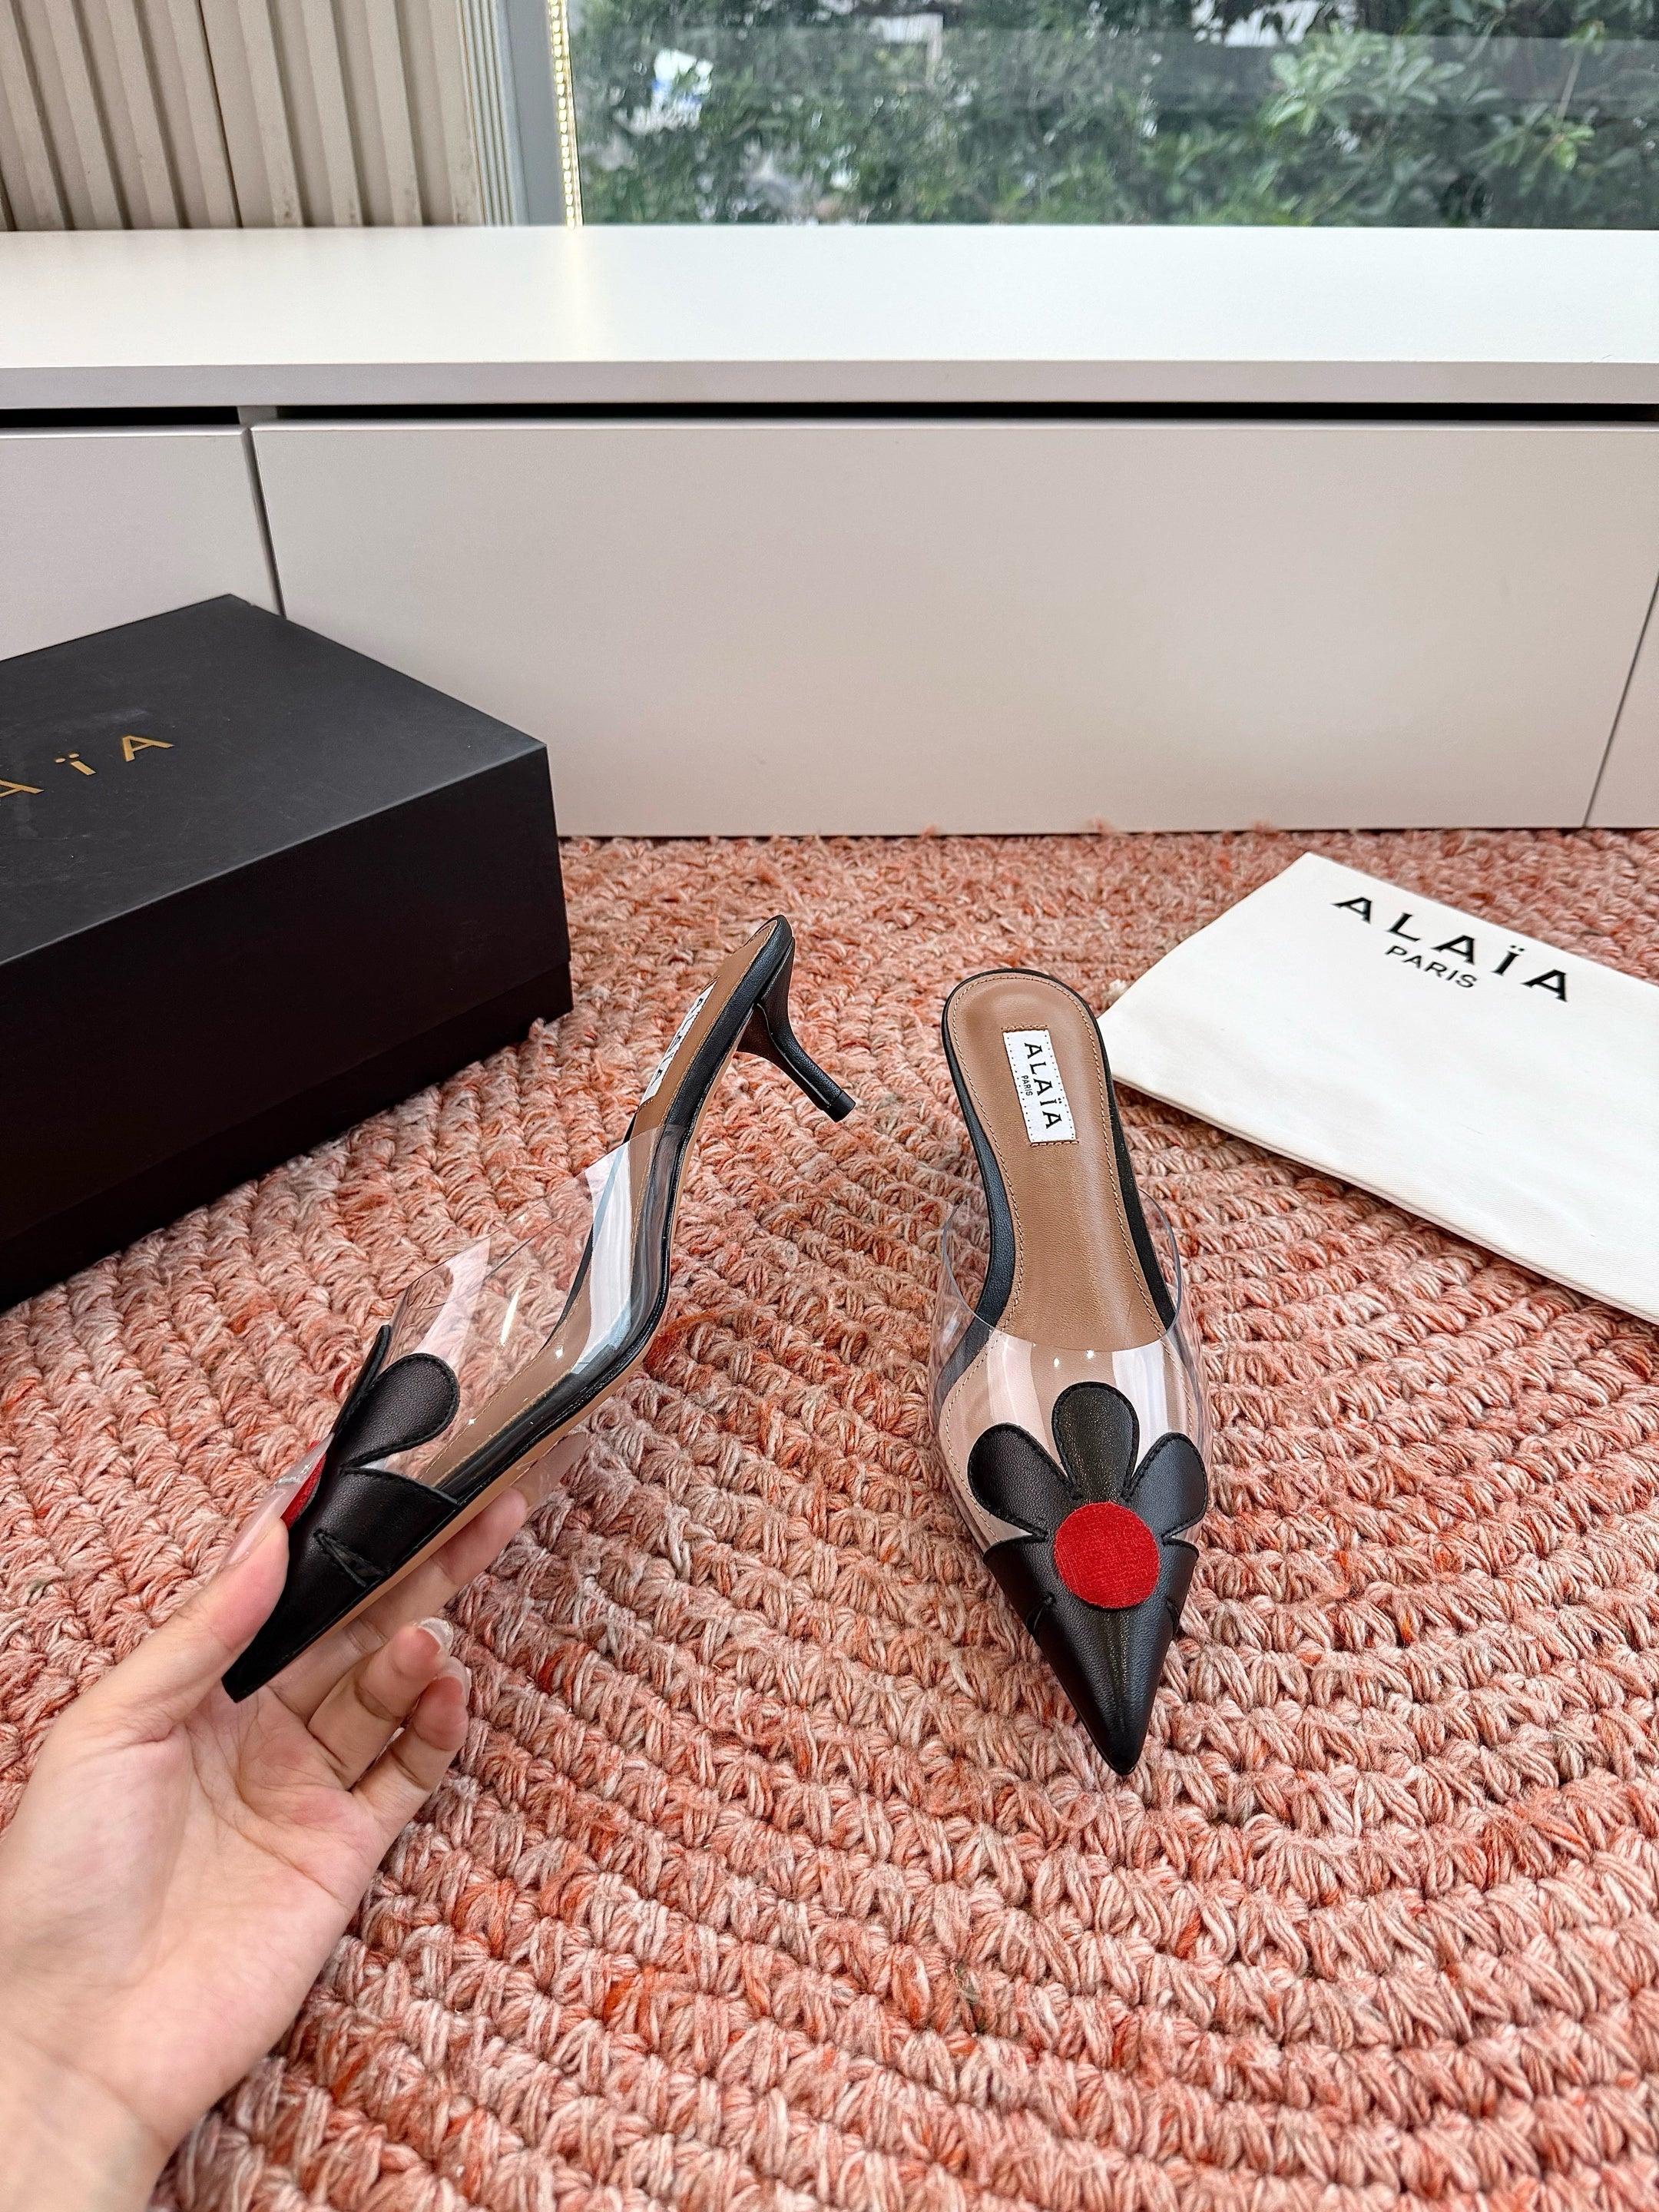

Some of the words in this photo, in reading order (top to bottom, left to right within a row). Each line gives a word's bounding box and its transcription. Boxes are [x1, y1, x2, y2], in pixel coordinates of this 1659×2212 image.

[1330, 896, 1568, 1002] ALAÏA
[1384, 945, 1477, 988] PARIS
[1021, 1075, 1033, 1096] PARIS
[1024, 1042, 1062, 1129] ALAÏA
